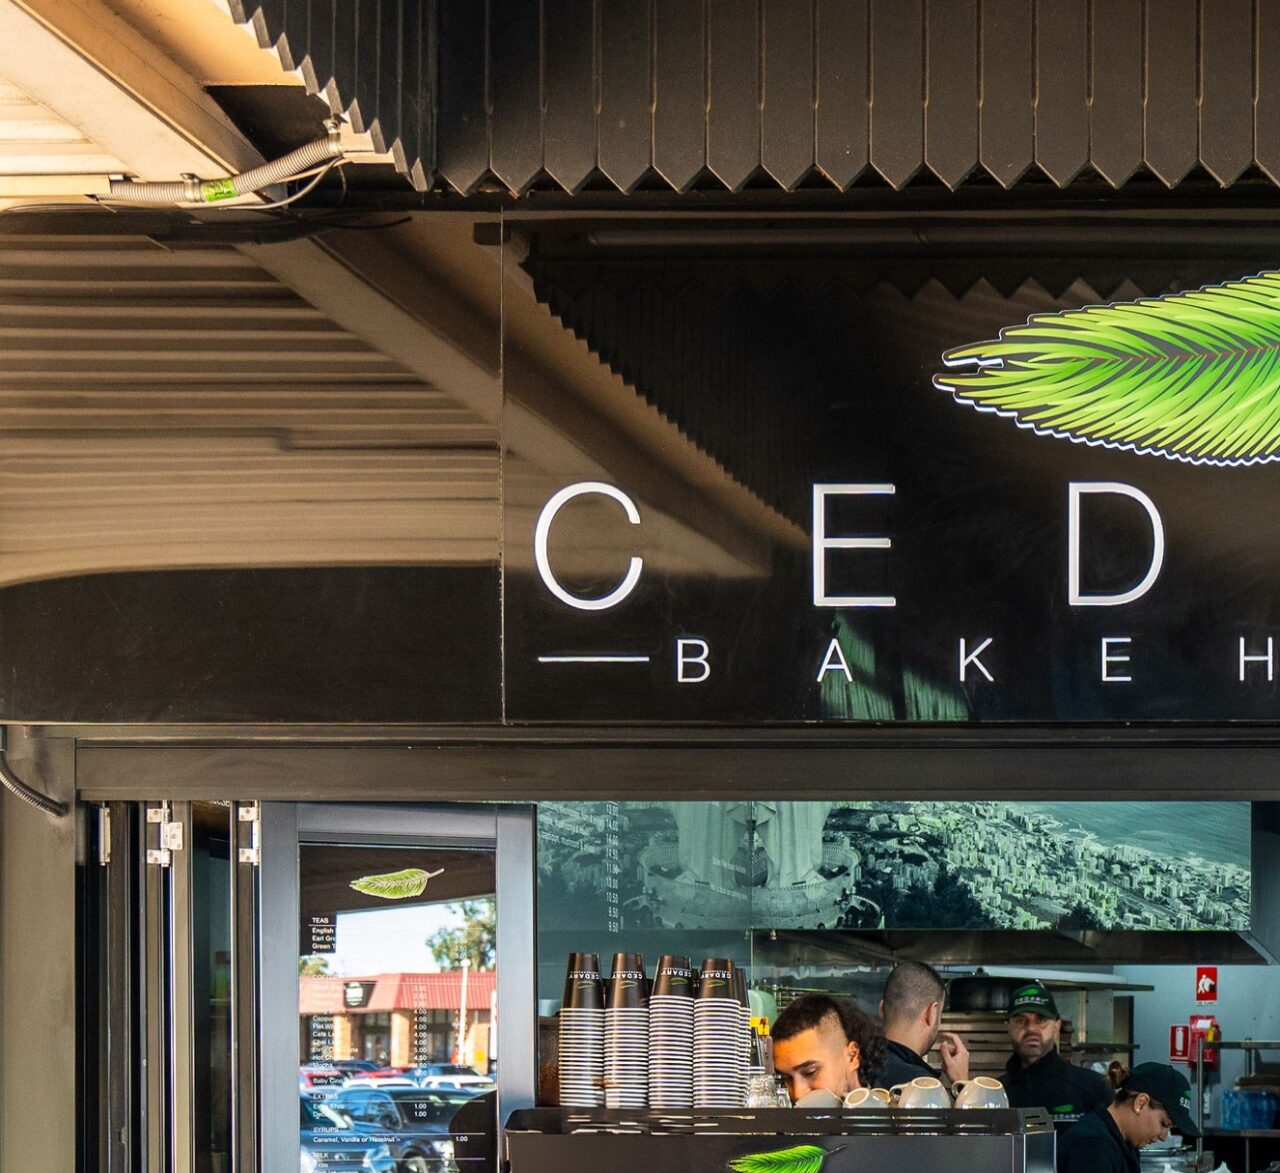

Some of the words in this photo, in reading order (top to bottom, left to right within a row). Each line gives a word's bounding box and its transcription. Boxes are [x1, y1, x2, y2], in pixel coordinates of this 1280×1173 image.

[312, 927, 335, 935] English
[312, 942, 331, 950] Green
[660, 969, 693, 978] CEDARY
[700, 972, 732, 980] CEDARY
